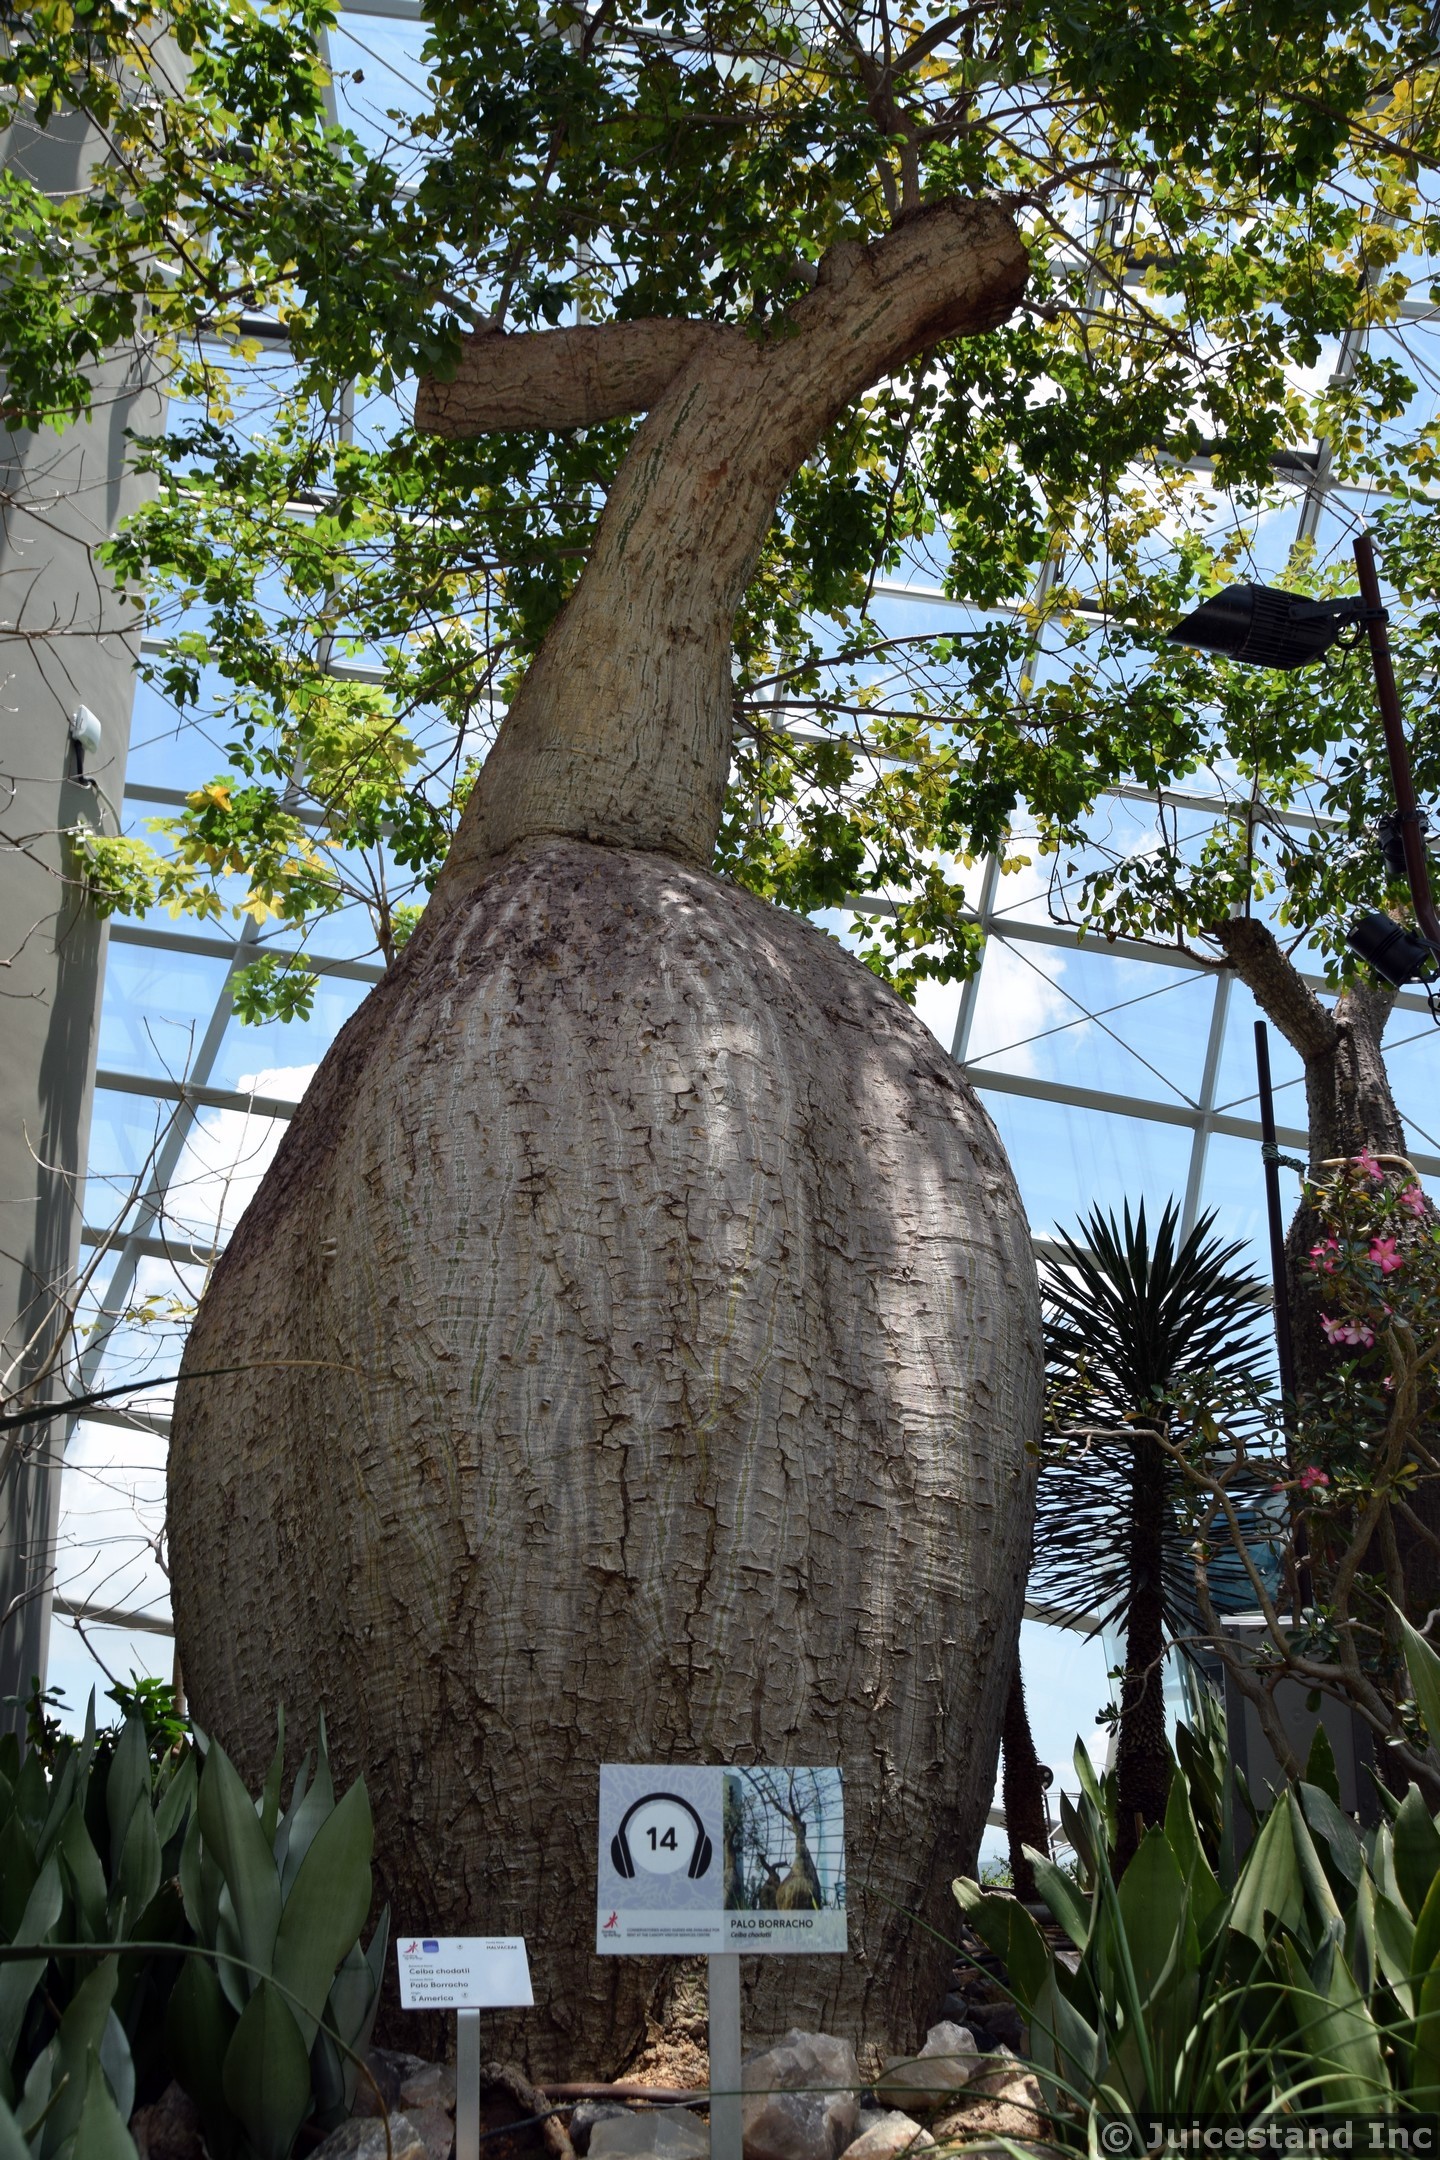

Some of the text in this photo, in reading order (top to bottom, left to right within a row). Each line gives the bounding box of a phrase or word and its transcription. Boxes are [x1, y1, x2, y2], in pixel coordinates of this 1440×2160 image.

[646, 1826, 678, 1851] 14
[730, 1919, 814, 1929] PALO BORRACHO
